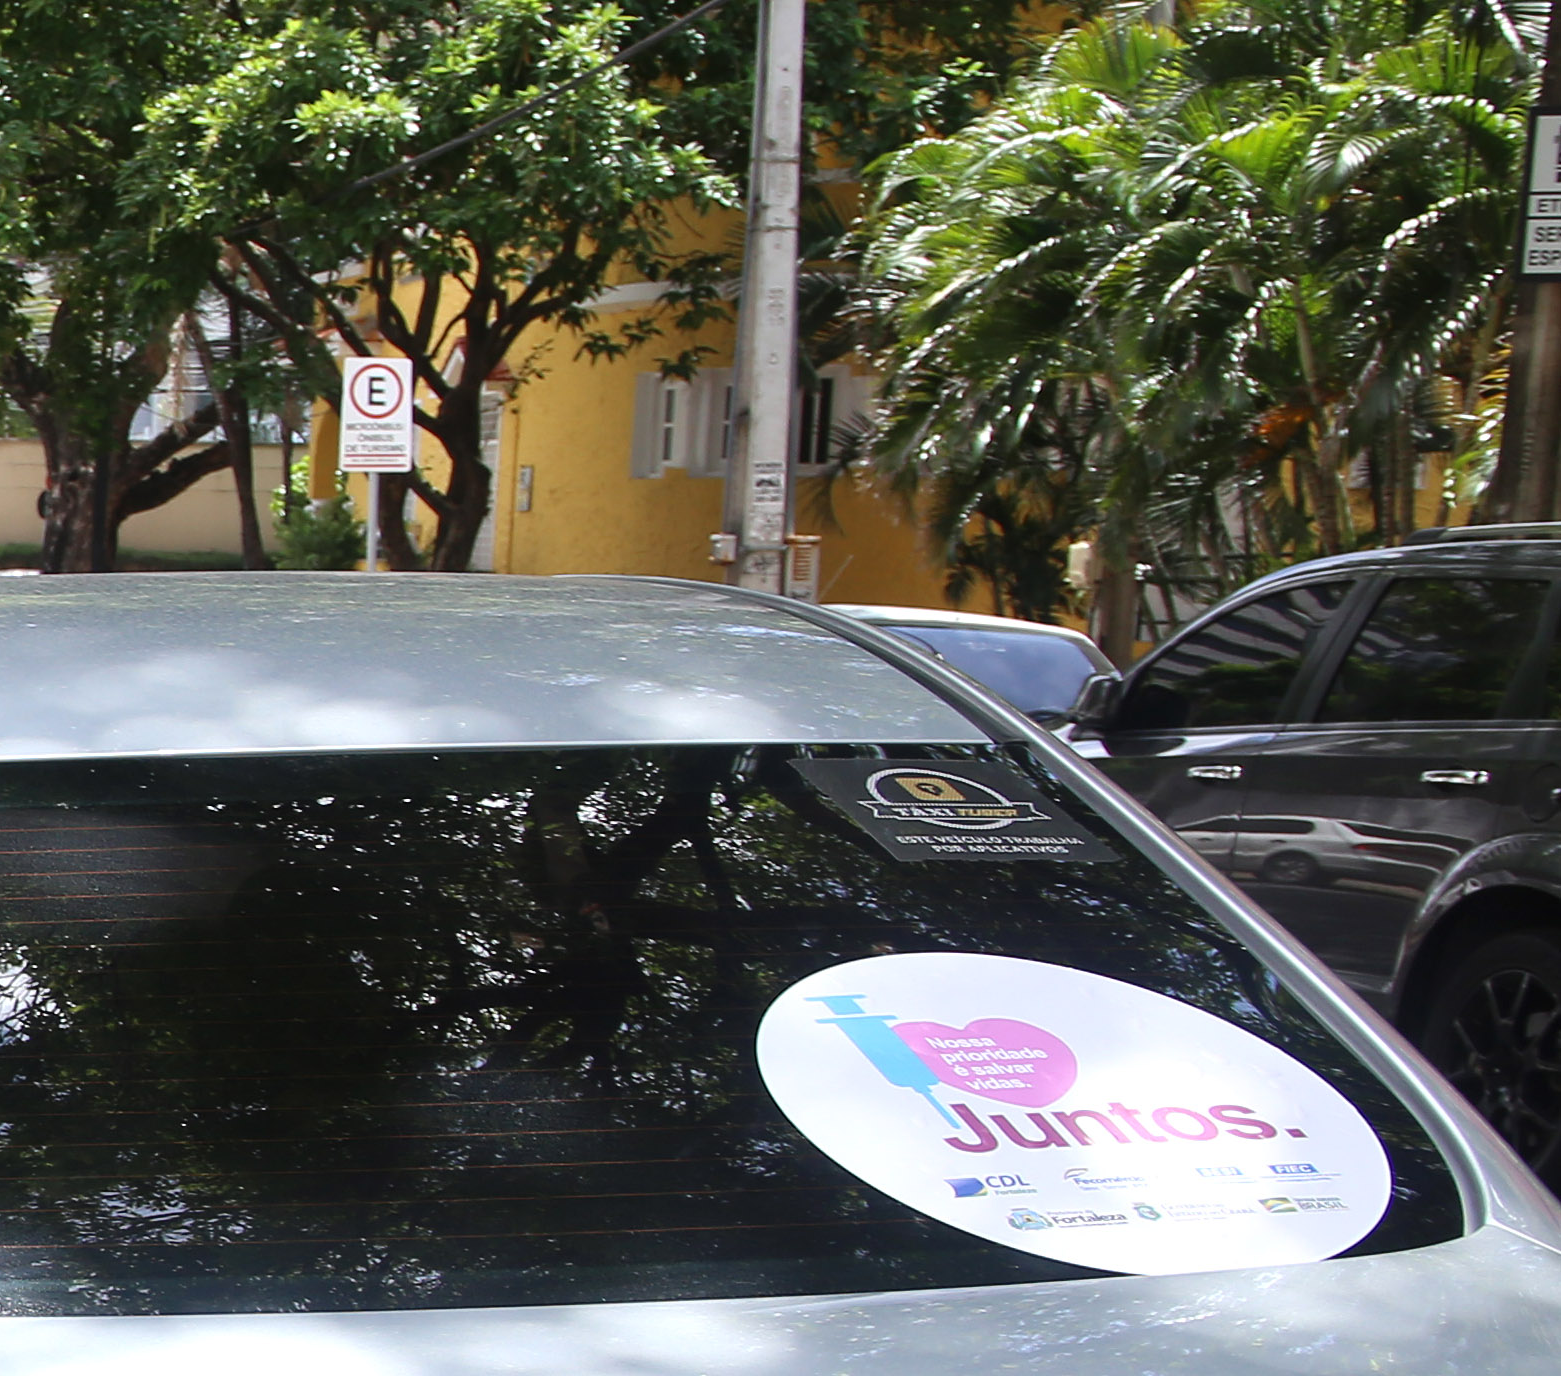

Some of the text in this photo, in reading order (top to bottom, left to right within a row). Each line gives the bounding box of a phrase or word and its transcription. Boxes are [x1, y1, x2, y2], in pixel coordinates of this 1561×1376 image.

[368, 376, 386, 406] E
[895, 835, 936, 844] ESTE
[1002, 836, 1085, 845] TRABALHA
[931, 845, 1070, 853] POR APLICATIVOS
[924, 1037, 998, 1050] Nossa
[939, 1046, 1049, 1066] prioridade
[952, 1062, 1036, 1077] é salvar
[965, 1077, 1033, 1091] vidas.
[943, 1101, 1309, 1155] Juntos.
[1278, 1165, 1313, 1173] FIEC
[985, 1174, 1031, 1189] CDL
[1298, 1200, 1349, 1210] BRASIL
[1051, 1211, 1128, 1226] Fortaleza
